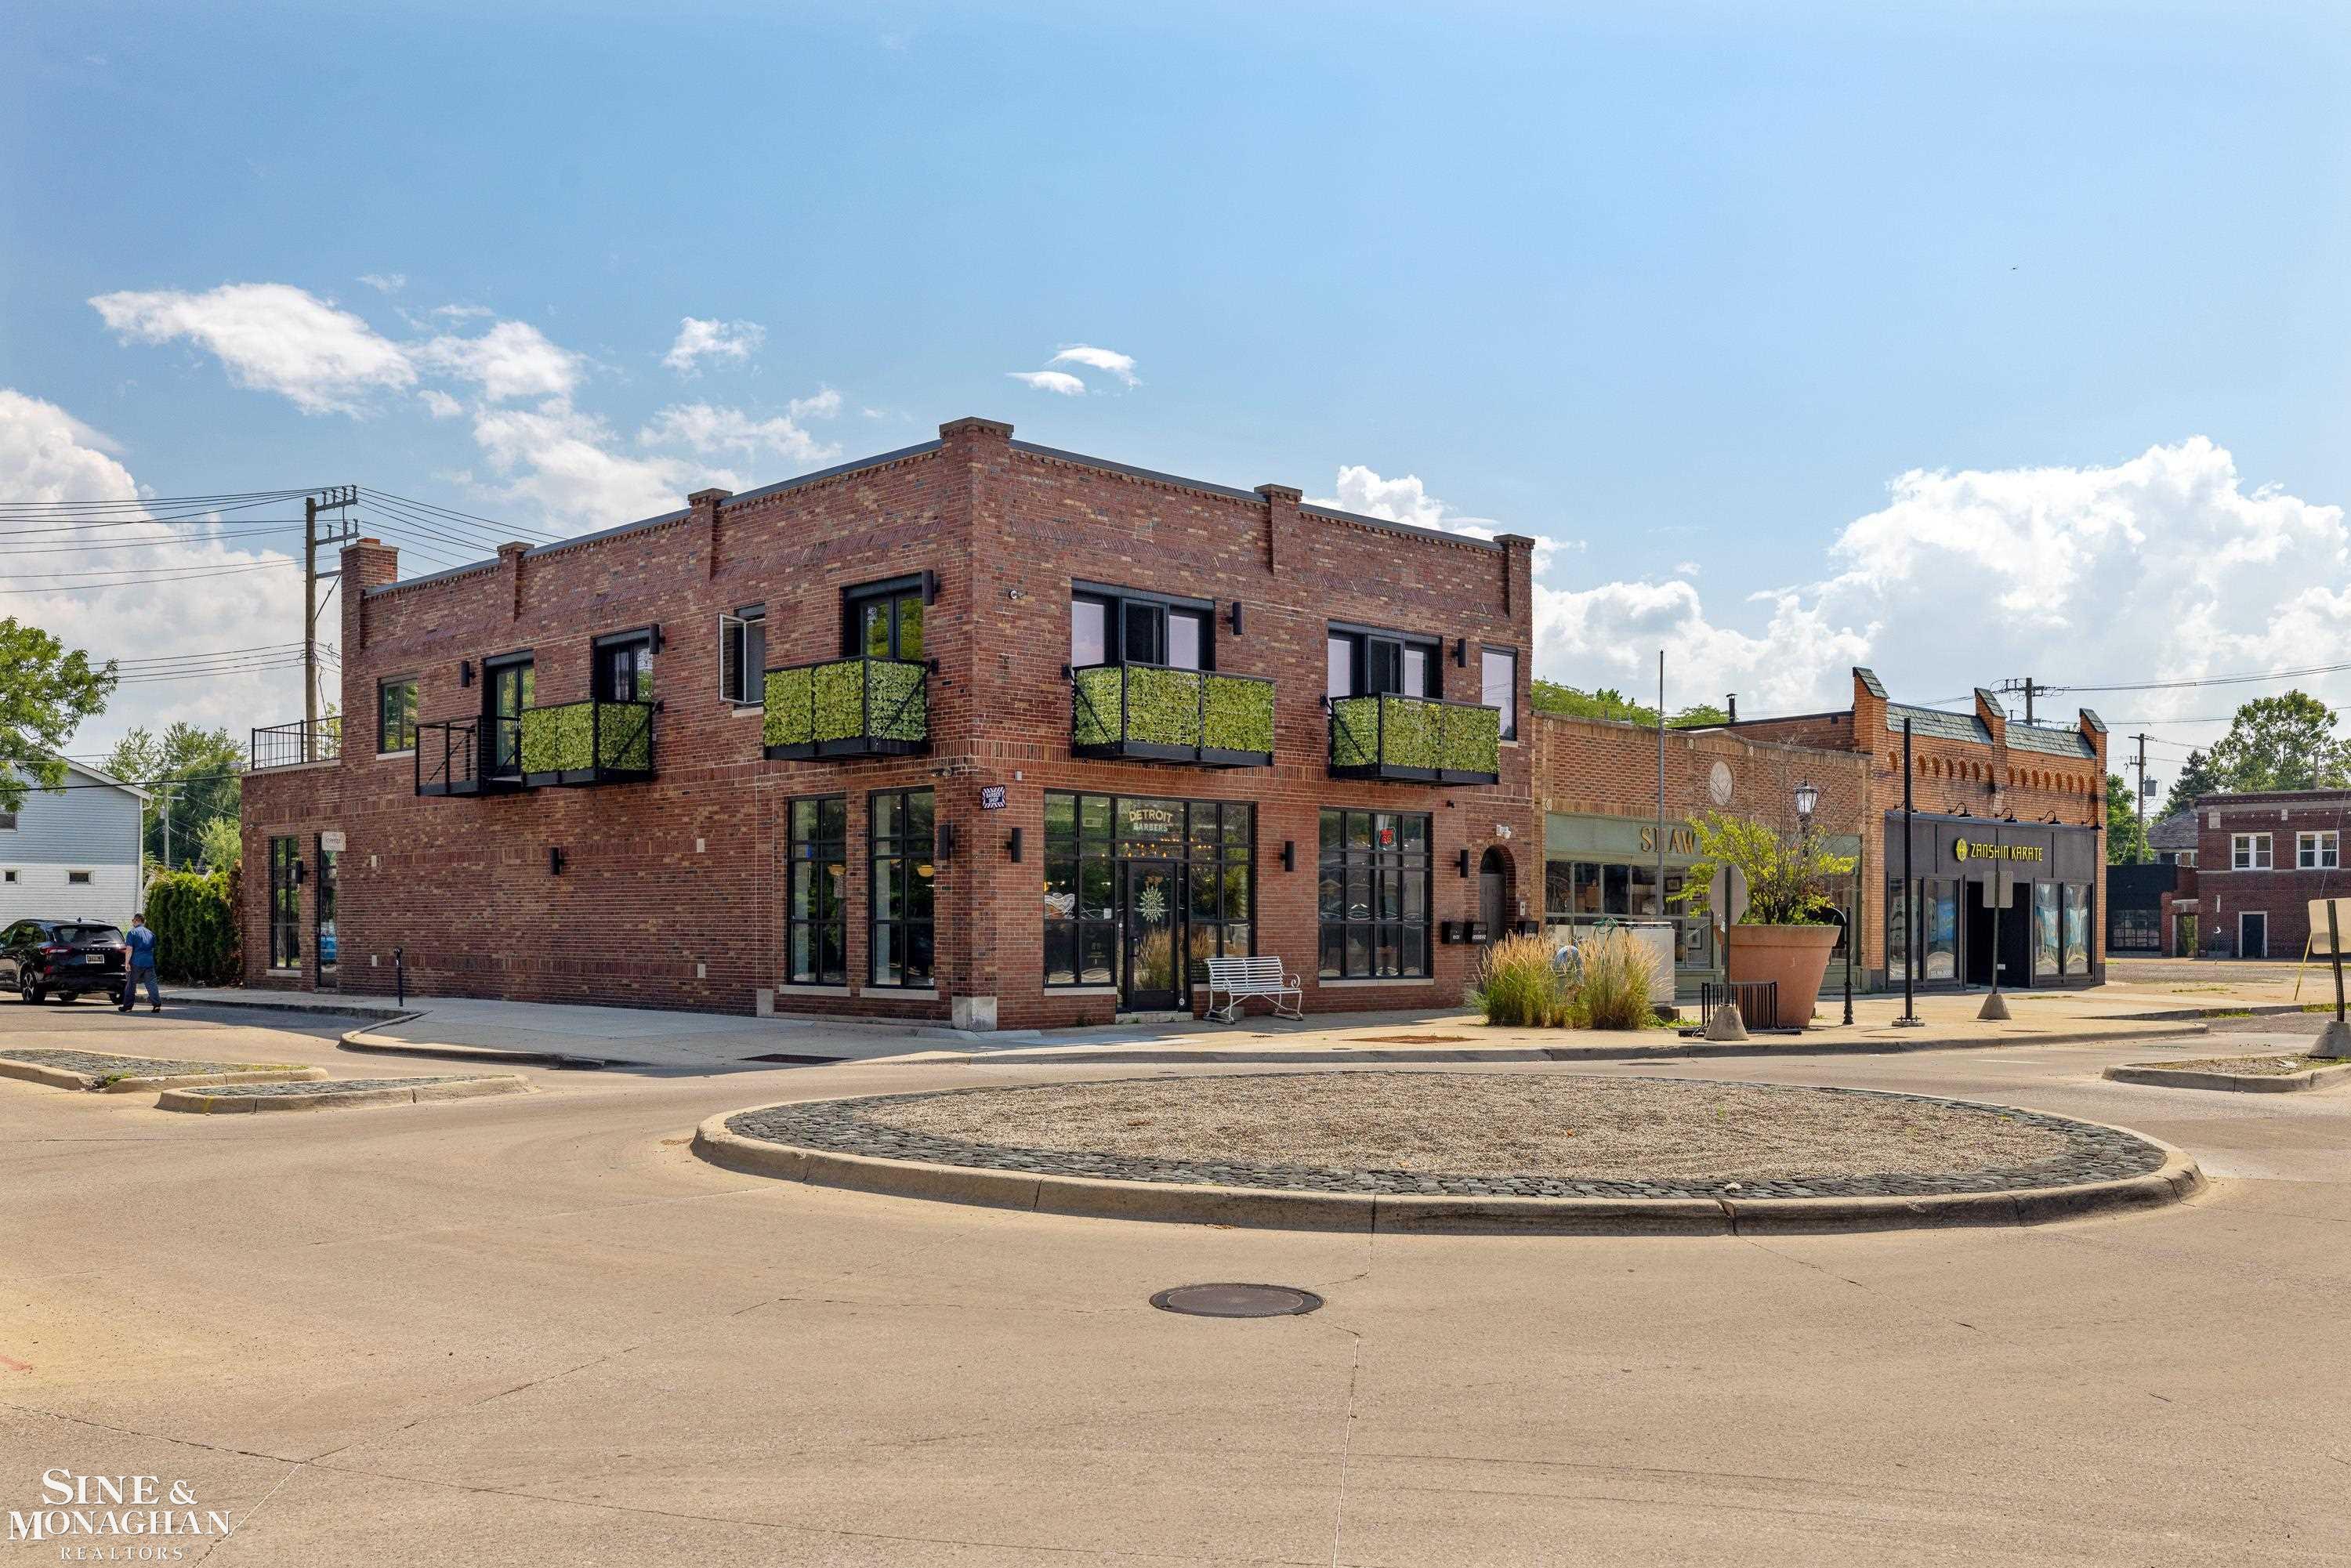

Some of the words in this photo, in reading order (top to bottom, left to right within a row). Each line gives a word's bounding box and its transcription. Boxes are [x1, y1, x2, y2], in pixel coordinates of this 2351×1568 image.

[1128, 809, 1173, 823] DETROIT
[1133, 823, 1168, 831] BARBERS
[1971, 843, 2009, 860] ZANSHIN
[2012, 846, 2043, 862] KARATE
